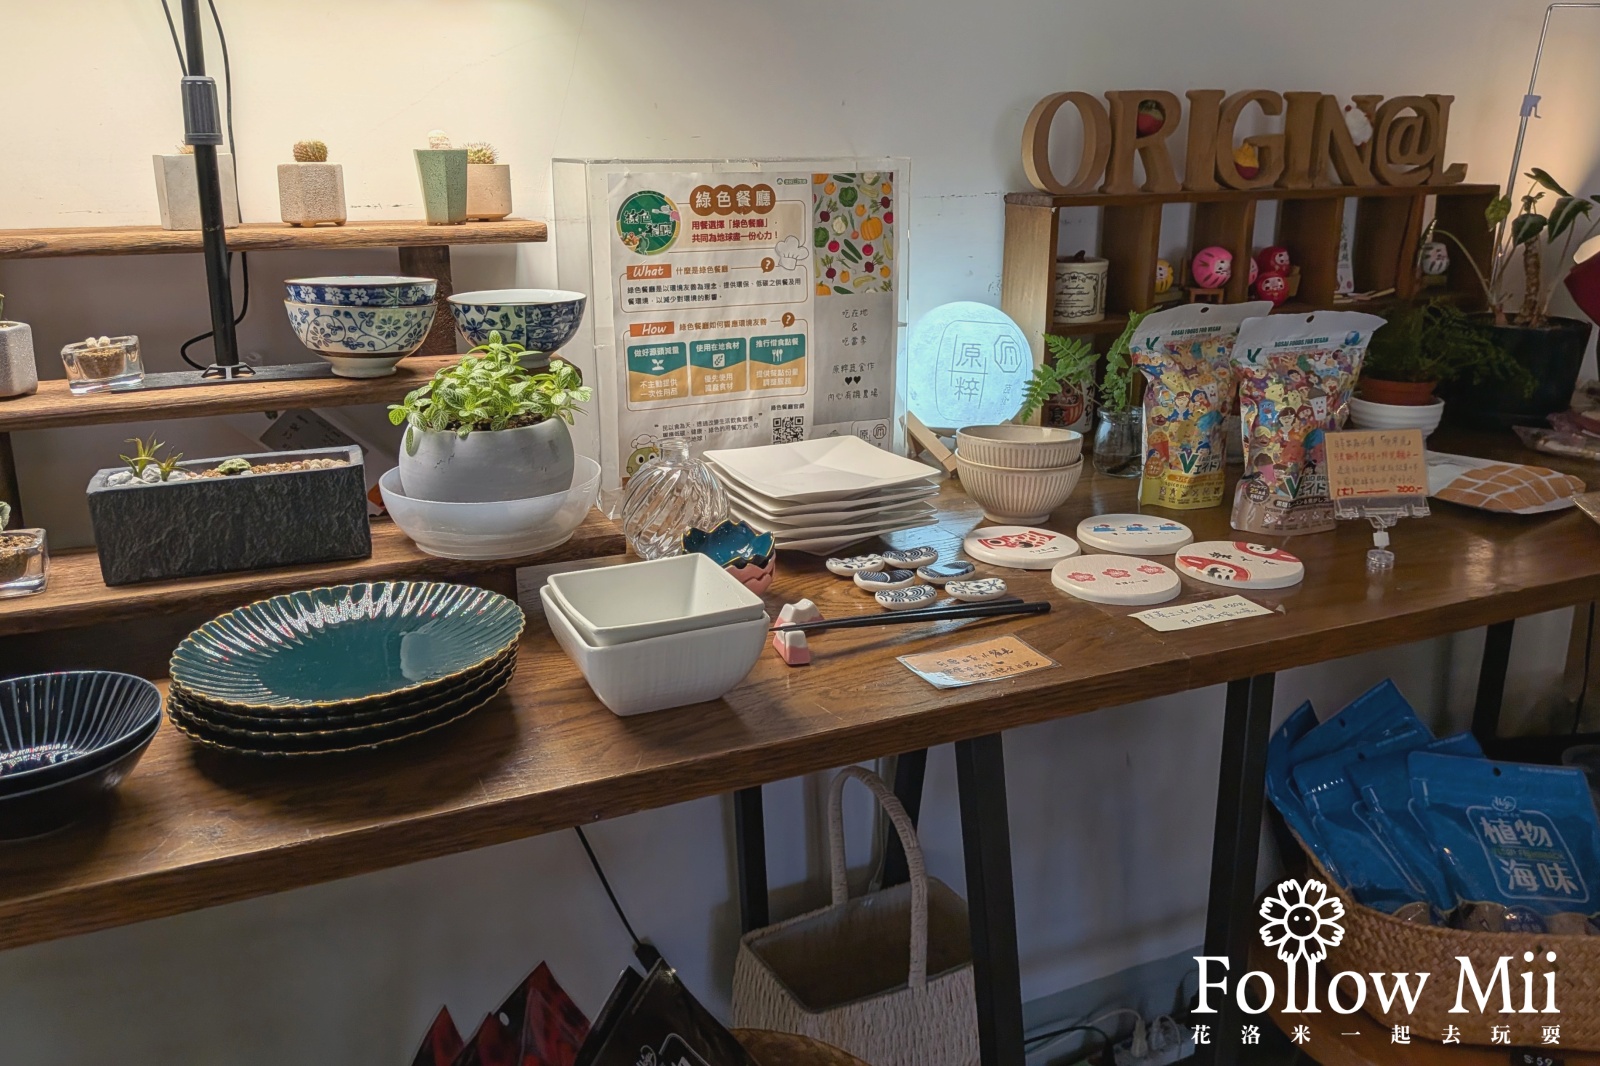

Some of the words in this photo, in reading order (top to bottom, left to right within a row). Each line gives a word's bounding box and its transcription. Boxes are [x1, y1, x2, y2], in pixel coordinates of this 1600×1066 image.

[695, 189, 771, 209] 綠色餐廳
[632, 266, 664, 278] What
[642, 324, 667, 335] How
[696, 342, 740, 352] 使用在地食材
[704, 373, 733, 383] 優先使用
[954, 343, 981, 402] 原粹
[640, 378, 678, 389] 不主動提供
[640, 388, 678, 397] 一次性用品
[1480, 816, 1554, 847] 植物
[1495, 857, 1579, 895] 海味
